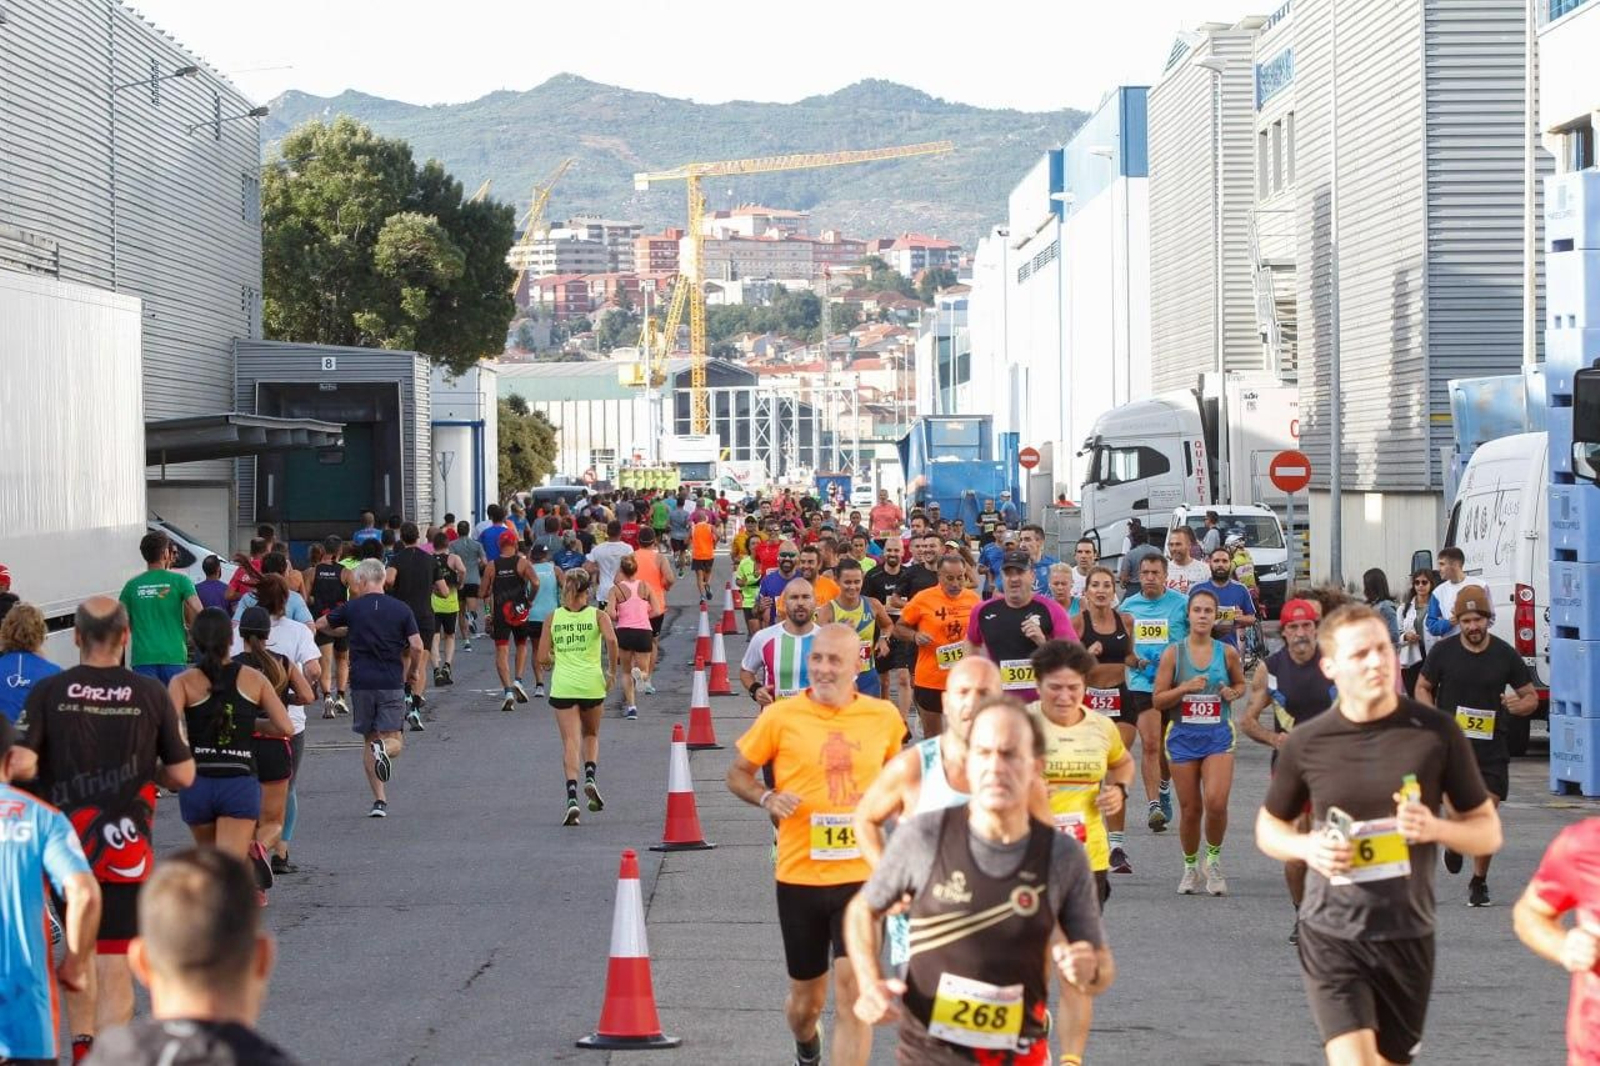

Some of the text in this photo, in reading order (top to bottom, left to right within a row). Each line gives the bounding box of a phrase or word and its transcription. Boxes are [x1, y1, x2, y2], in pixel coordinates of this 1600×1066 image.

[325, 358, 332, 369] 8
[576, 622, 593, 633] que
[1140, 625, 1162, 637] 309
[566, 633, 586, 646] plan
[943, 648, 963, 662] 315
[1008, 667, 1033, 681] 307
[67, 683, 133, 702] CARMA
[1090, 696, 1115, 709] 452
[1189, 703, 1214, 716] 403
[1467, 716, 1484, 730] 52
[1359, 838, 1375, 863] 6
[951, 1000, 1009, 1030] 268
